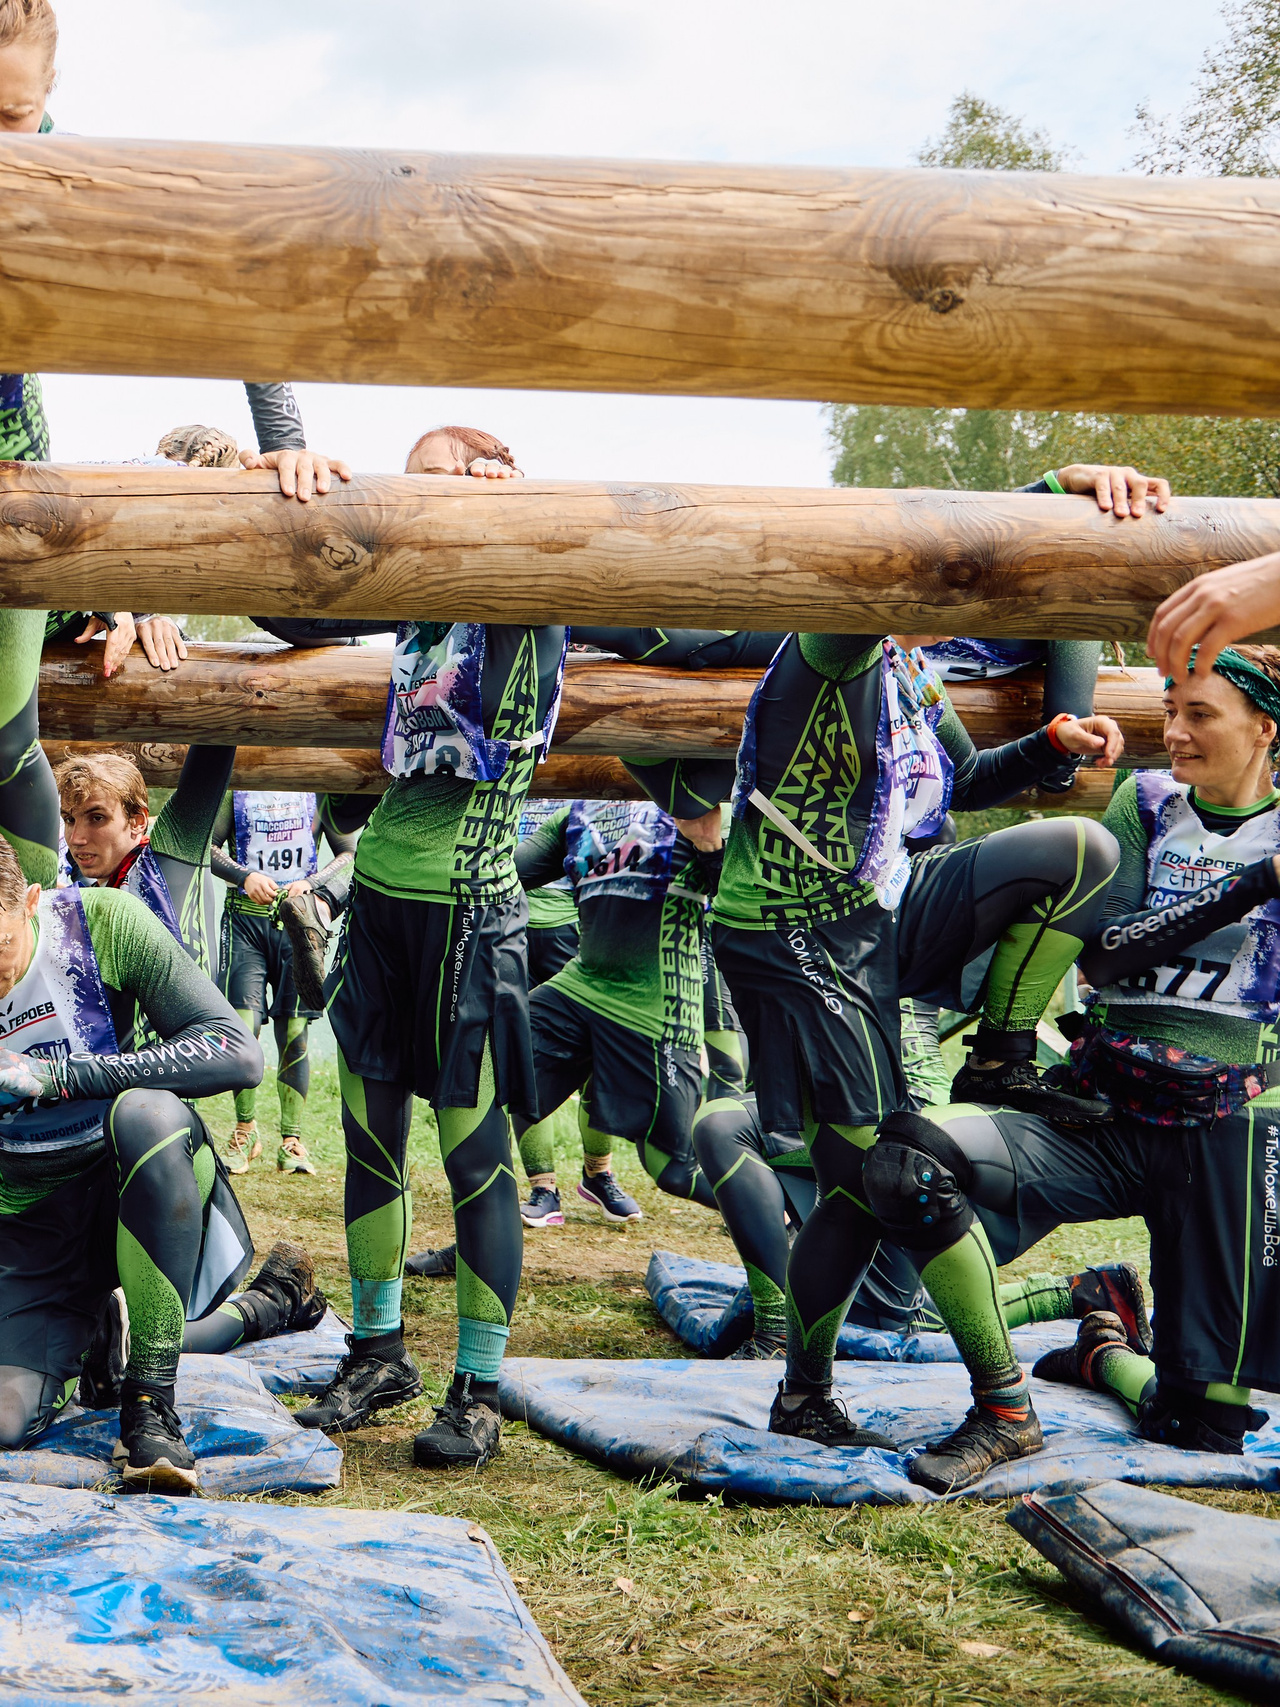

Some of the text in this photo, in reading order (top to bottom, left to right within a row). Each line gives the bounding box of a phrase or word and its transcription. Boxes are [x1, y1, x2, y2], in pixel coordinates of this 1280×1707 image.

[256, 818, 302, 831] МАССОВЫЙ
[268, 831, 291, 841] СТАРТ
[256, 847, 303, 870] 1491
[1102, 883, 1223, 950] Greenway
[450, 906, 476, 1023] ТыМожешьВсё
[788, 928, 843, 1014] Grenway
[9, 1001, 56, 1030] ГЕРОЕВ
[70, 1035, 213, 1065] Greenway
[118, 1064, 191, 1077] GLOBAL
[30, 1114, 101, 1142] ГАЗПРОМБАНК
[1263, 1125, 1280, 1267] #ТыМожешьВсё
